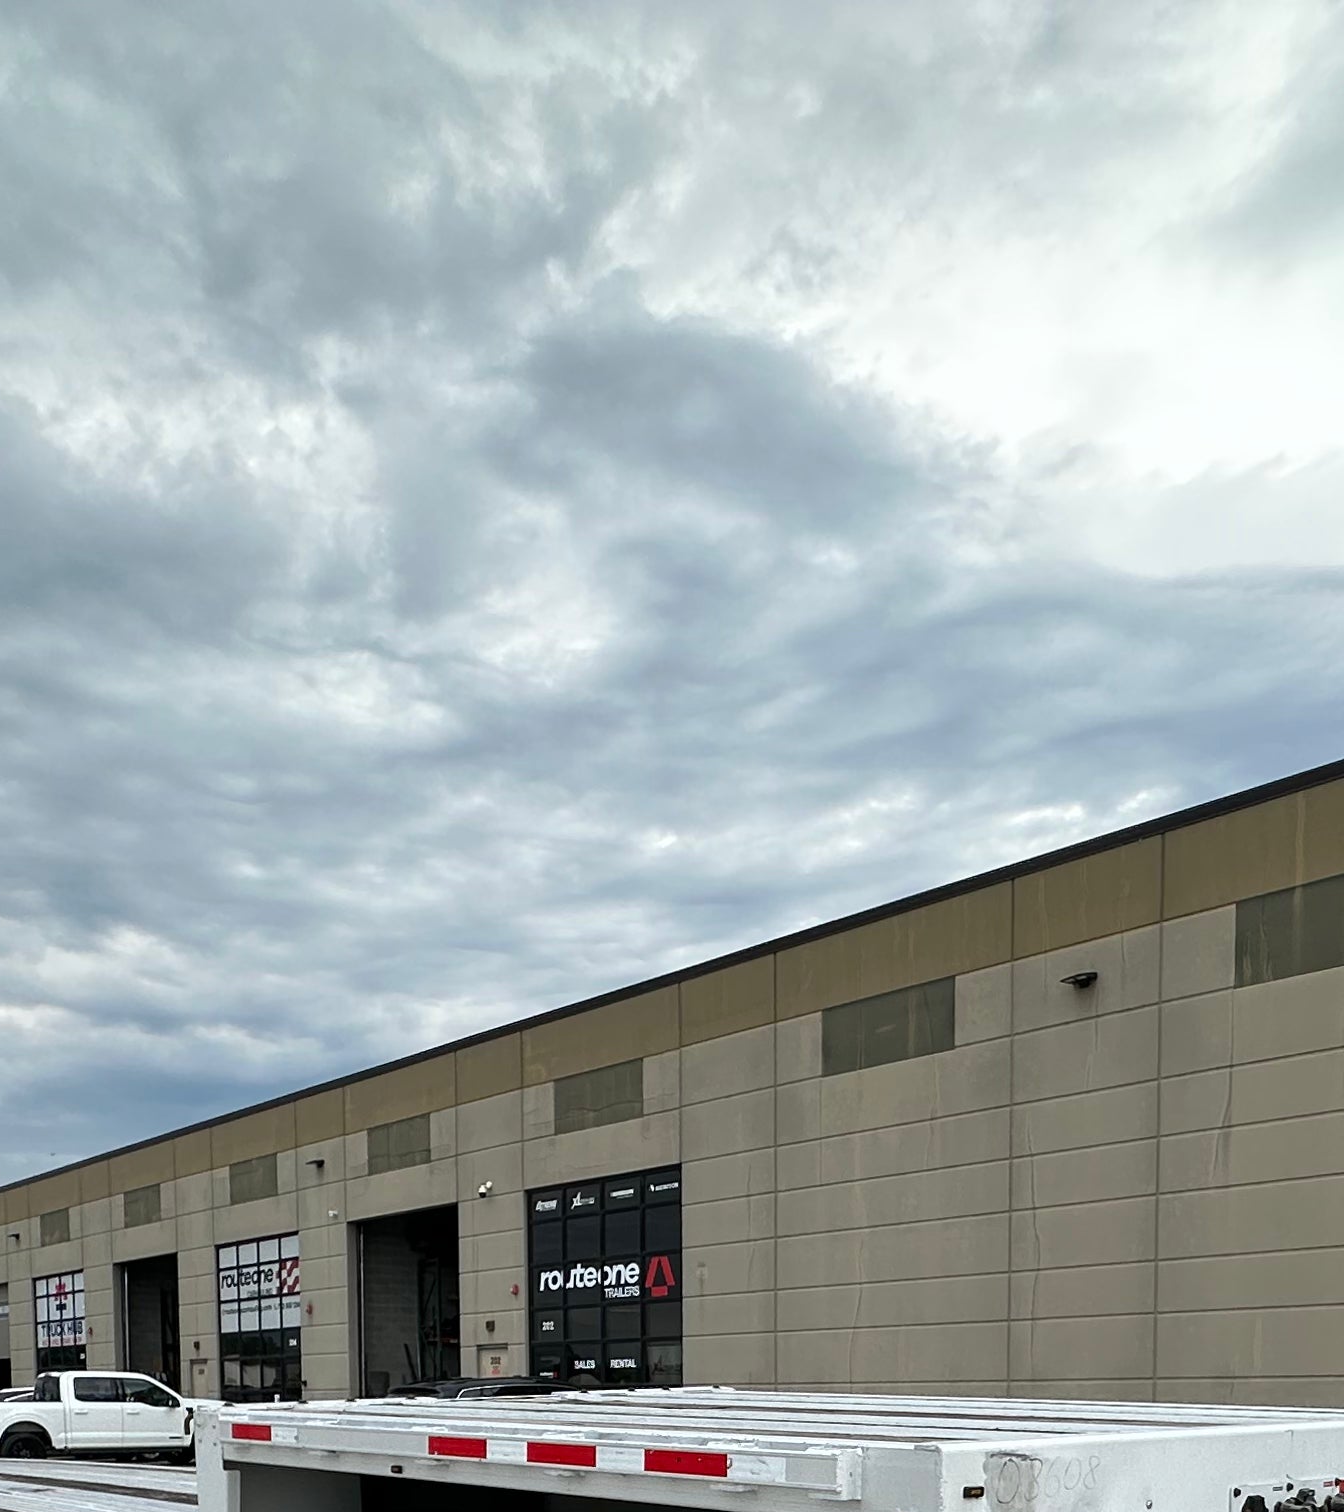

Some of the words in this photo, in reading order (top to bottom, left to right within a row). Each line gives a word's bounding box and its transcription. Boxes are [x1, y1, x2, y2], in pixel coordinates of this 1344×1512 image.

[539, 1262, 640, 1291] routeone
[604, 1286, 640, 1298] TRAILERS
[41, 1323, 66, 1338] TUCK
[574, 1360, 596, 1369] SALES
[610, 1358, 637, 1368] RENTAL
